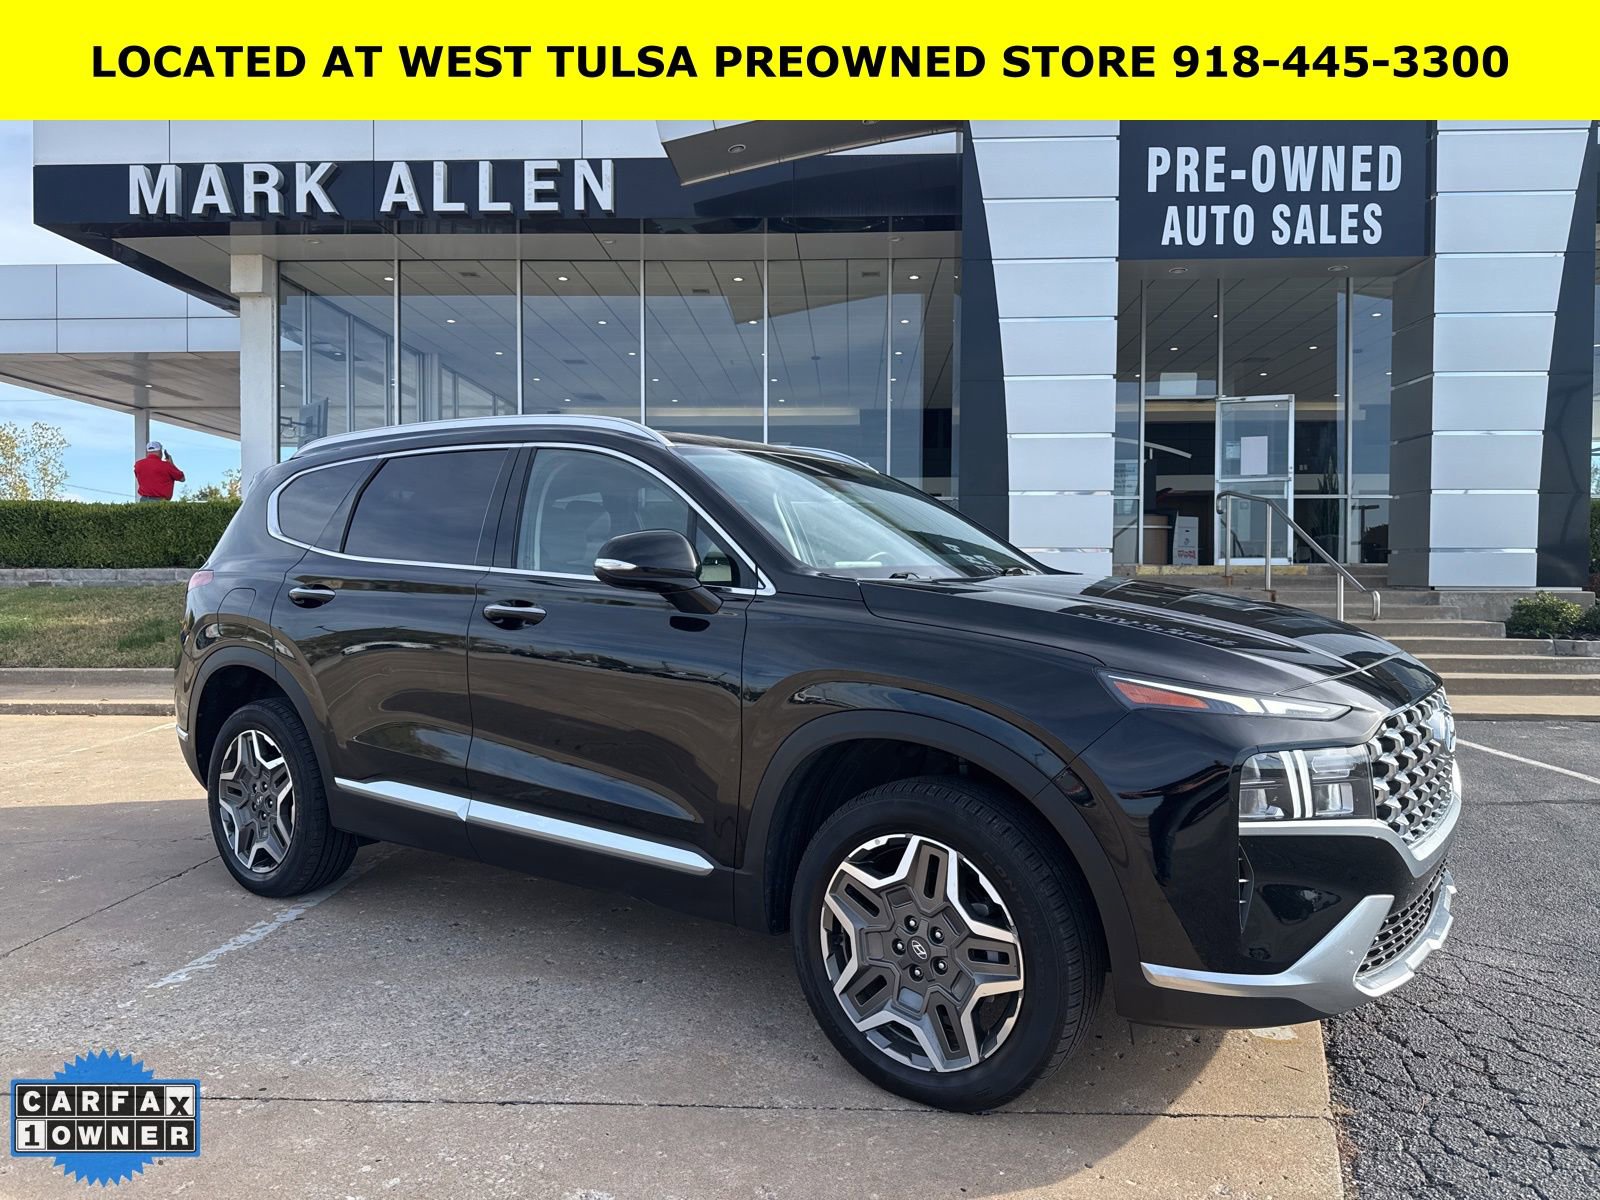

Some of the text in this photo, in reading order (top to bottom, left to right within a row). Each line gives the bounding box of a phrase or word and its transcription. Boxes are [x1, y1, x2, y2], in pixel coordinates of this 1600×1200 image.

[128, 159, 616, 217] MARK ALLEN
[1147, 144, 1402, 193] PRE-OWNED
[1161, 202, 1383, 246] AUTO SALES
